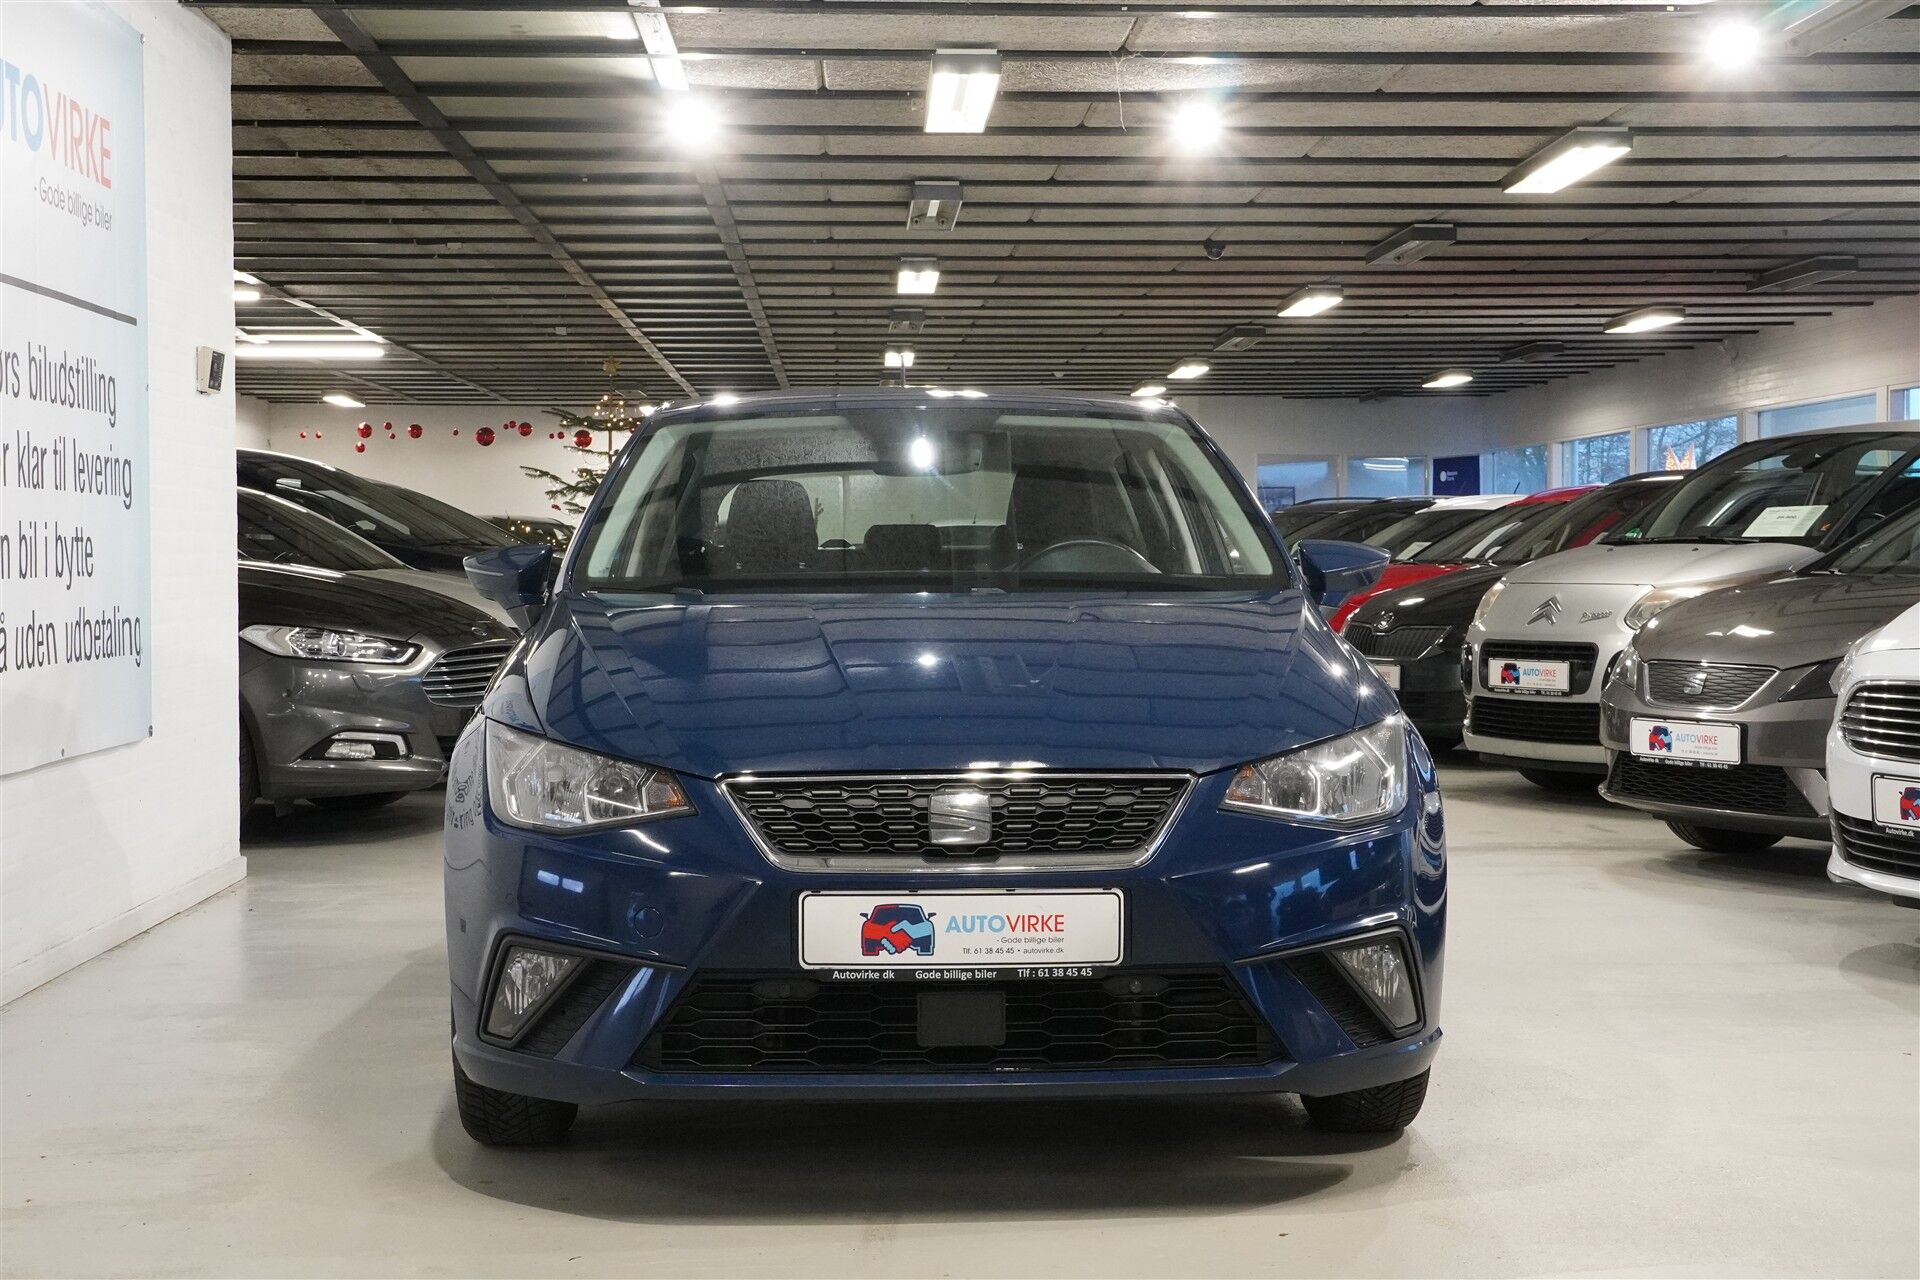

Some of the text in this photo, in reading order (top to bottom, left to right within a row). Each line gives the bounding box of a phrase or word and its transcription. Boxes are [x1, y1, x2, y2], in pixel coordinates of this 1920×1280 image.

[39, 176, 65, 211] Gode
[67, 188, 93, 227] billige
[95, 202, 112, 232] biler
[28, 341, 117, 428] biludstilling
[17, 430, 47, 489] klar
[53, 436, 66, 491] til
[73, 438, 132, 510] levering
[19, 520, 37, 579] bil
[44, 521, 48, 578] i
[55, 521, 94, 590] bytte
[16, 610, 58, 670] uden
[65, 606, 141, 668] udbetaling
[1522, 668, 1557, 678] AUTOVIRKE
[1675, 733, 1718, 745] AUTOVIRKE
[945, 914, 1065, 933] AUTOVIRKE
[1001, 936, 1022, 944] Gode
[1024, 936, 1046, 945] billige
[1023, 947, 1065, 955] autovirke.dk
[832, 970, 895, 979] Autovirke dk
[915, 969, 997, 981] Gode billige biler
[1017, 968, 1030, 978] Tlf
[1037, 968, 1050, 977] 61
[1052, 968, 1064, 977] 38
[1065, 968, 1078, 977] 45
[1080, 968, 1093, 977] 45
